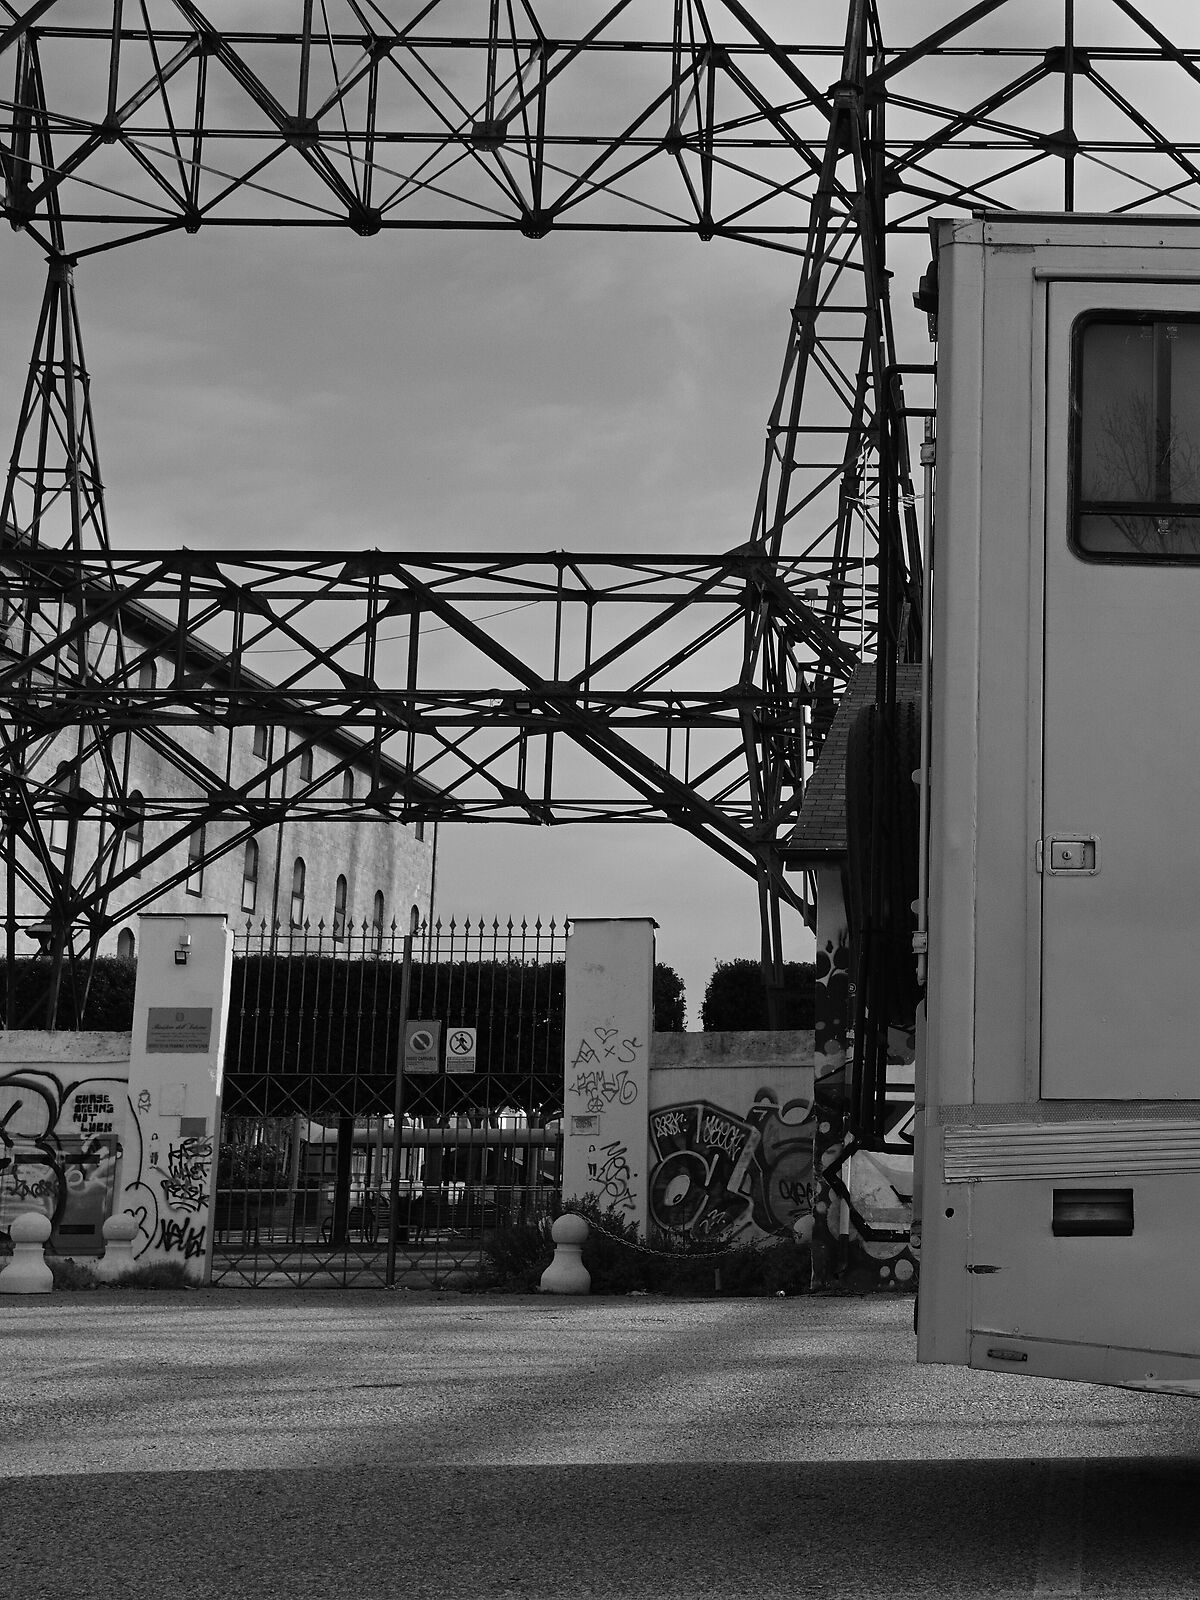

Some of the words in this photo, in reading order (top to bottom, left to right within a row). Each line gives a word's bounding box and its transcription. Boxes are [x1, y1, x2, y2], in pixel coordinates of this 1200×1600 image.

[75, 1094, 111, 1104] CHASE
[74, 1103, 114, 1113] DREAMS
[73, 1113, 97, 1123] NOT
